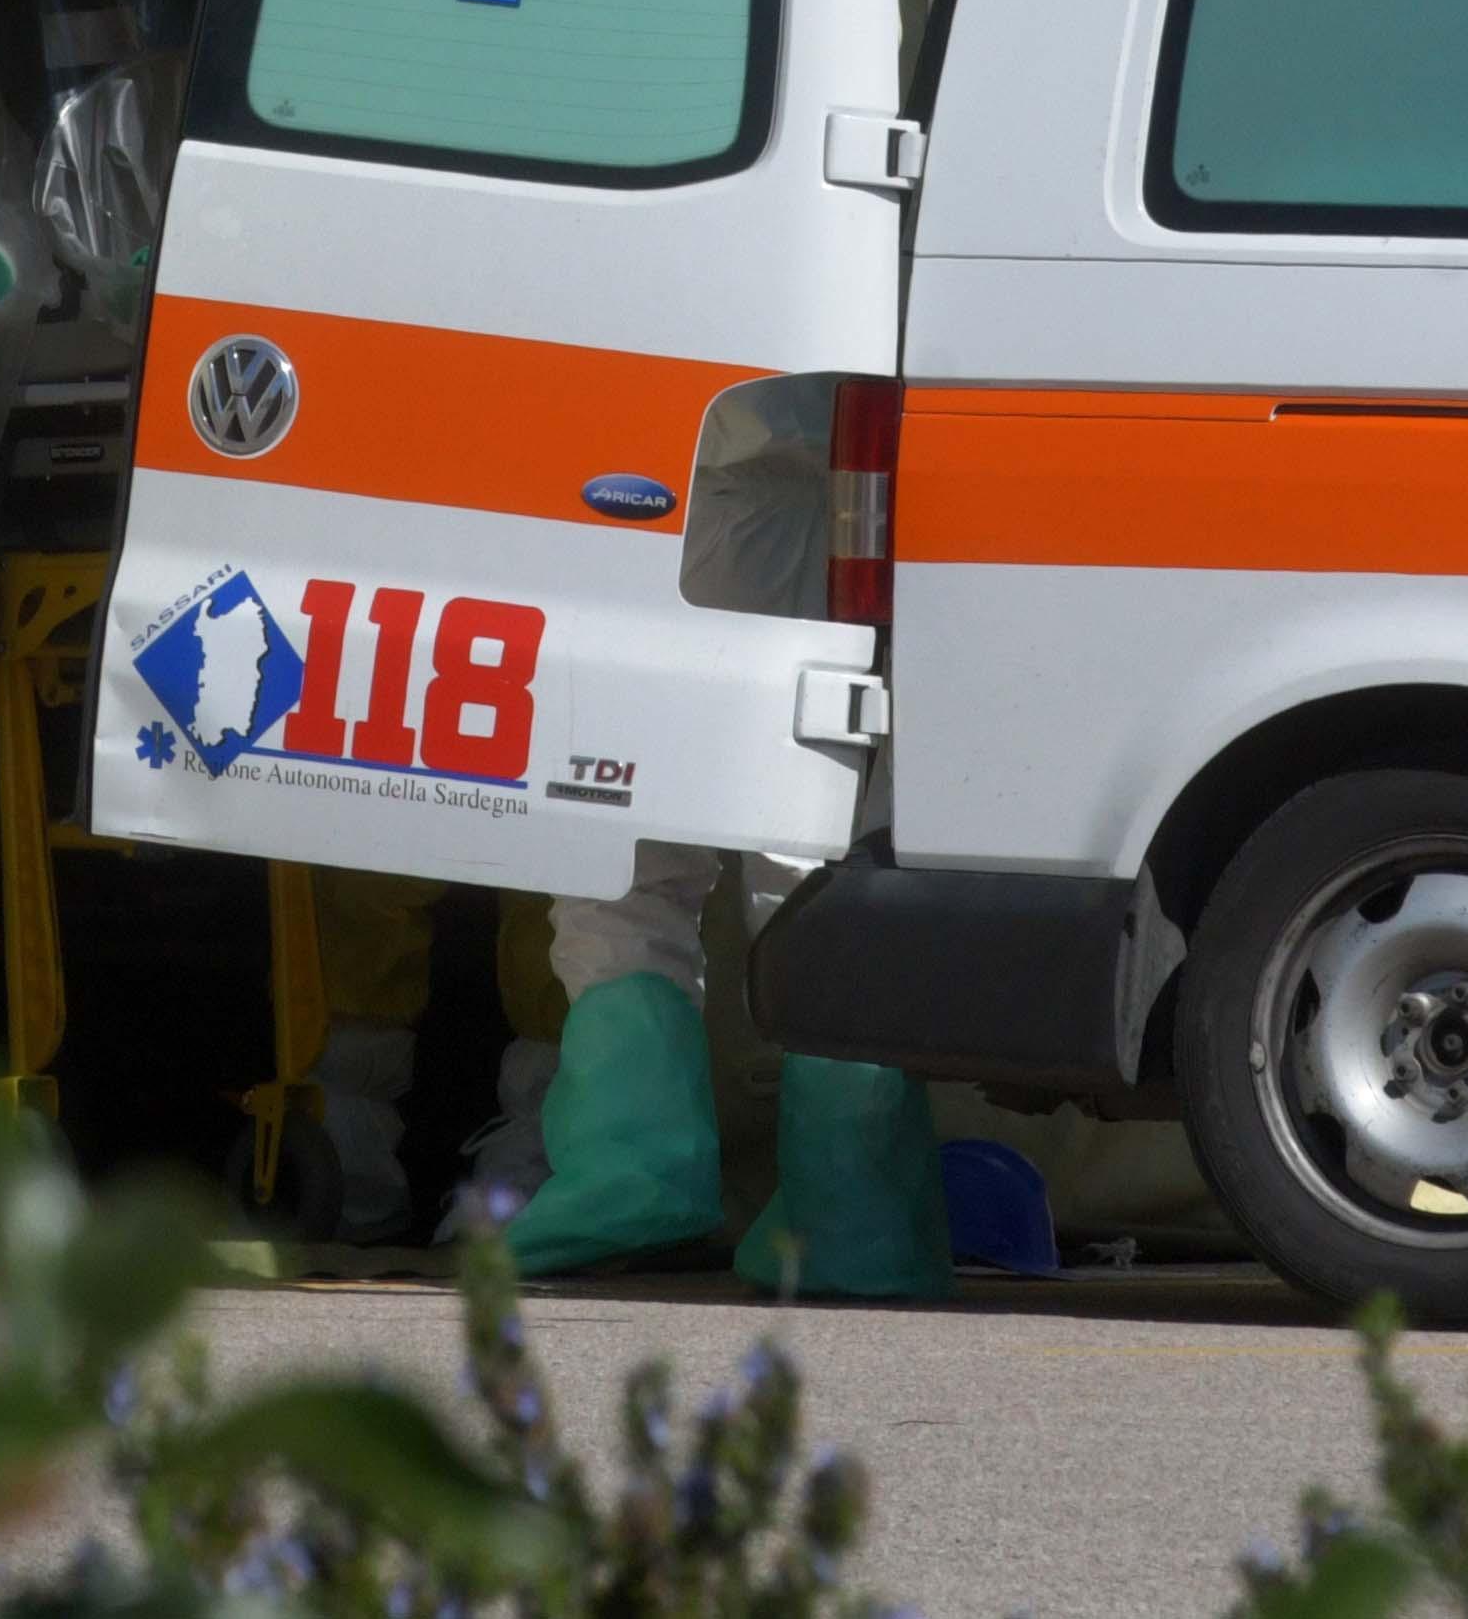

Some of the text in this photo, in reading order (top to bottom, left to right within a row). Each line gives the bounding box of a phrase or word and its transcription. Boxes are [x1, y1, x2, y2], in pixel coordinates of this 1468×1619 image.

[591, 486, 668, 508] ARICAR
[129, 562, 233, 652] SASSARI
[283, 578, 547, 782] 118
[182, 749, 529, 818] Regione Autonoma della Sardegna
[568, 754, 637, 787] TDI
